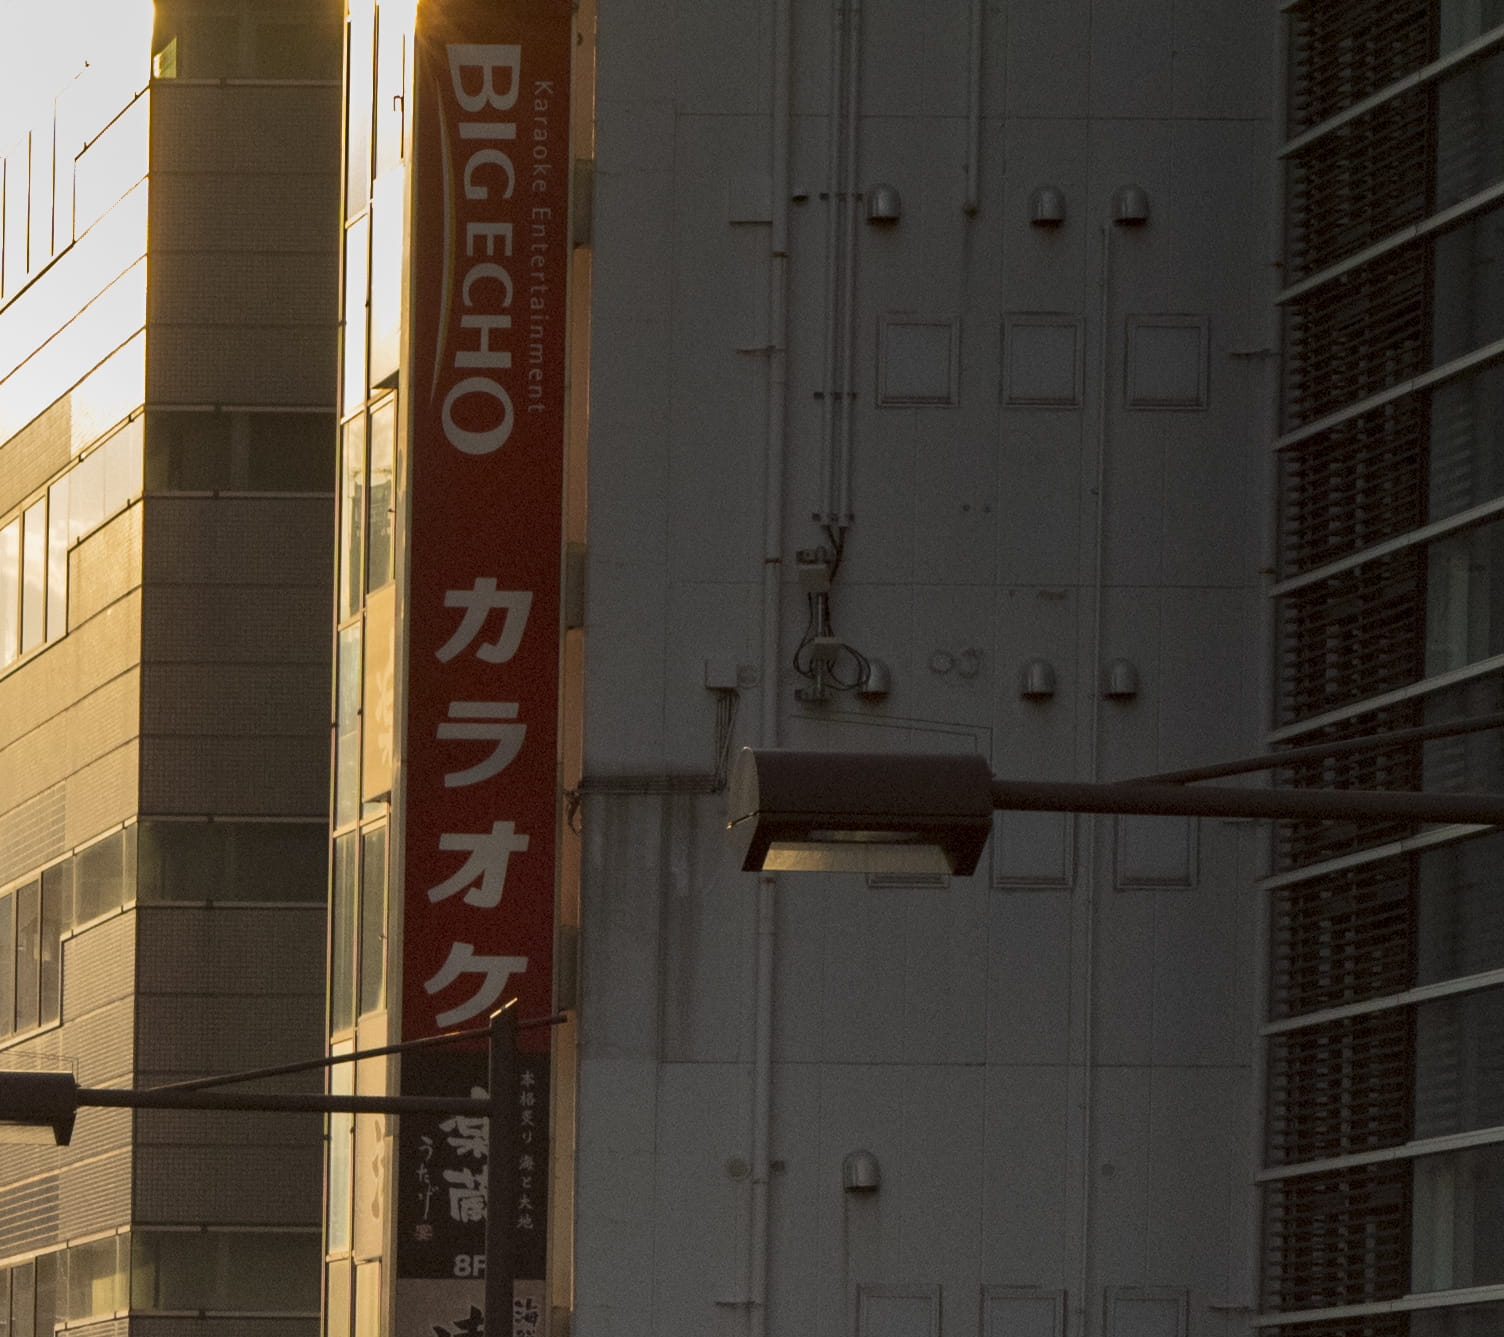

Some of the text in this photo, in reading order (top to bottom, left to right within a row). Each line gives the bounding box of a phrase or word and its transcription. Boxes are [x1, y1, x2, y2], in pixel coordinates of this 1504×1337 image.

[530, 79, 550, 413] Karaoke Entertainment
[423, 577, 533, 1028] カラオケ
